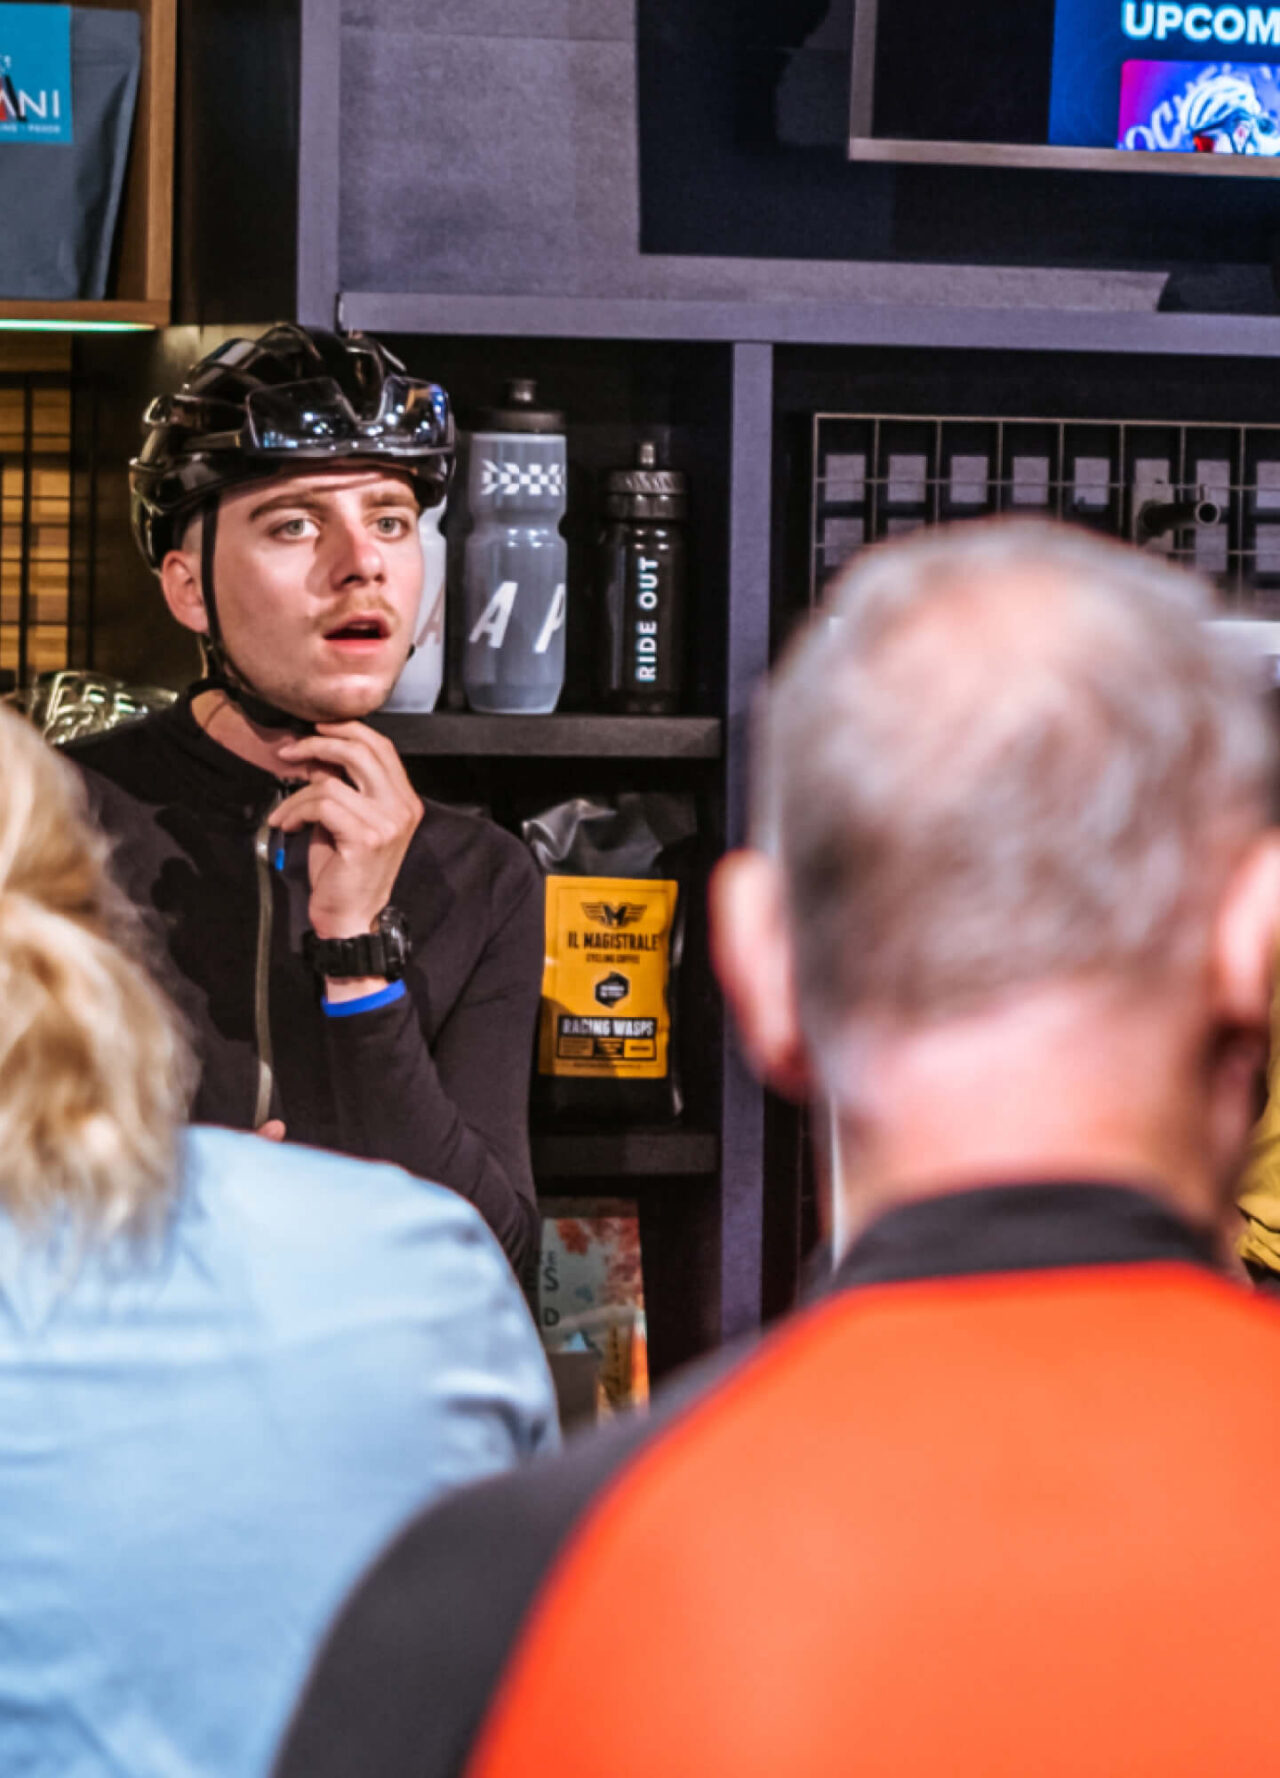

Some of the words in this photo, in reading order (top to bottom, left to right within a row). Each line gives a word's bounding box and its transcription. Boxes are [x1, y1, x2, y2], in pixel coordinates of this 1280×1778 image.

[638, 556, 659, 610] OUT
[636, 620, 658, 682] RIDE
[567, 931, 579, 950] IL
[583, 932, 659, 951] MAGISTRALE
[561, 1018, 611, 1036] RACING
[612, 1019, 655, 1037] WASPS
